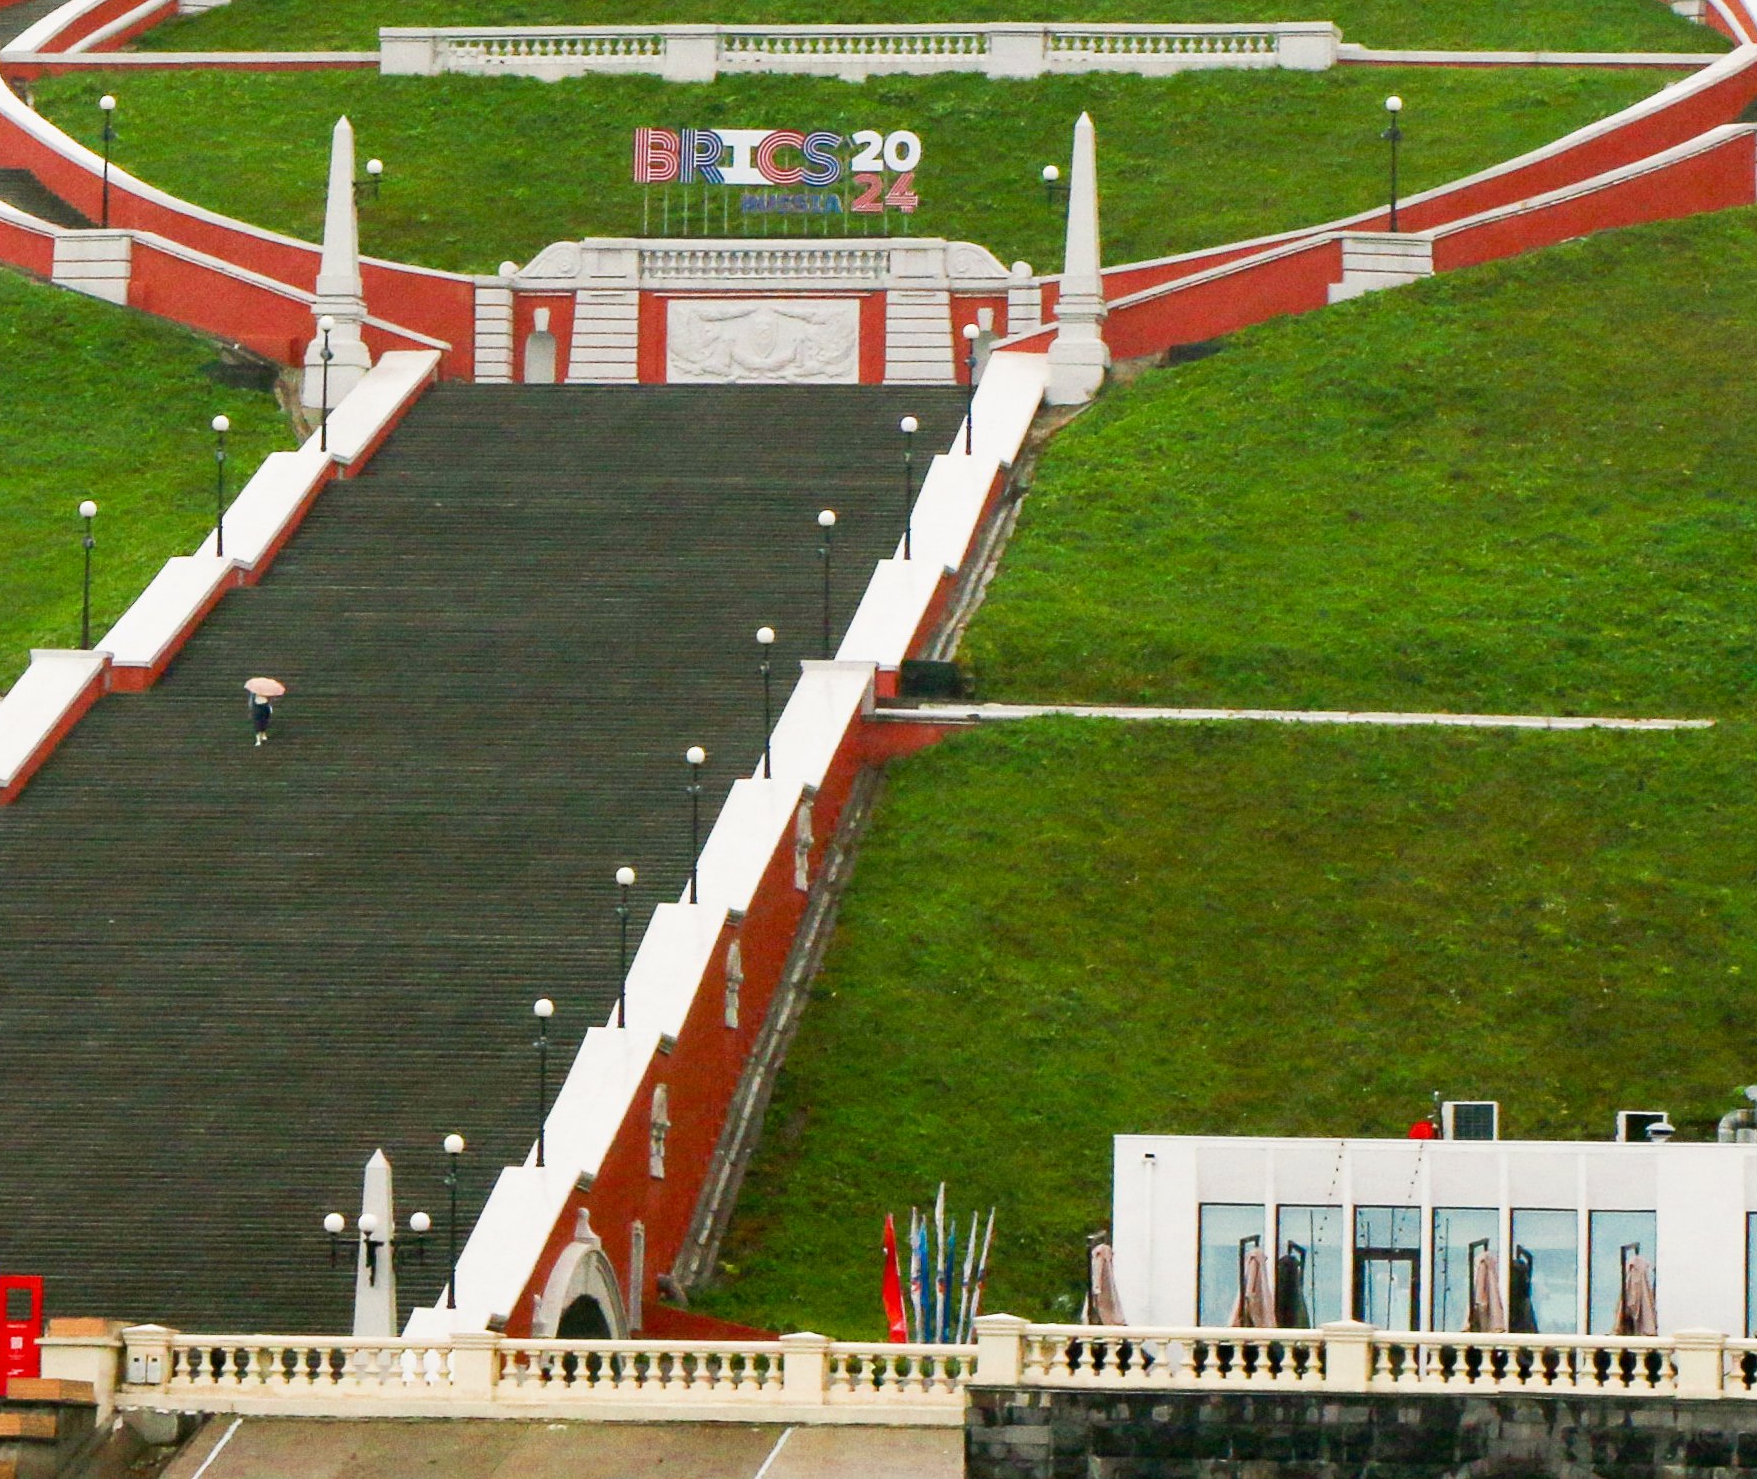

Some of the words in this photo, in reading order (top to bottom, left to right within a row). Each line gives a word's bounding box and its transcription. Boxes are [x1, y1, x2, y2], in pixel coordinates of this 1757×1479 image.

[634, 127, 841, 187] BRICS
[851, 129, 922, 172] 20
[741, 192, 843, 214] RUSSIA
[850, 172, 919, 214] 24
